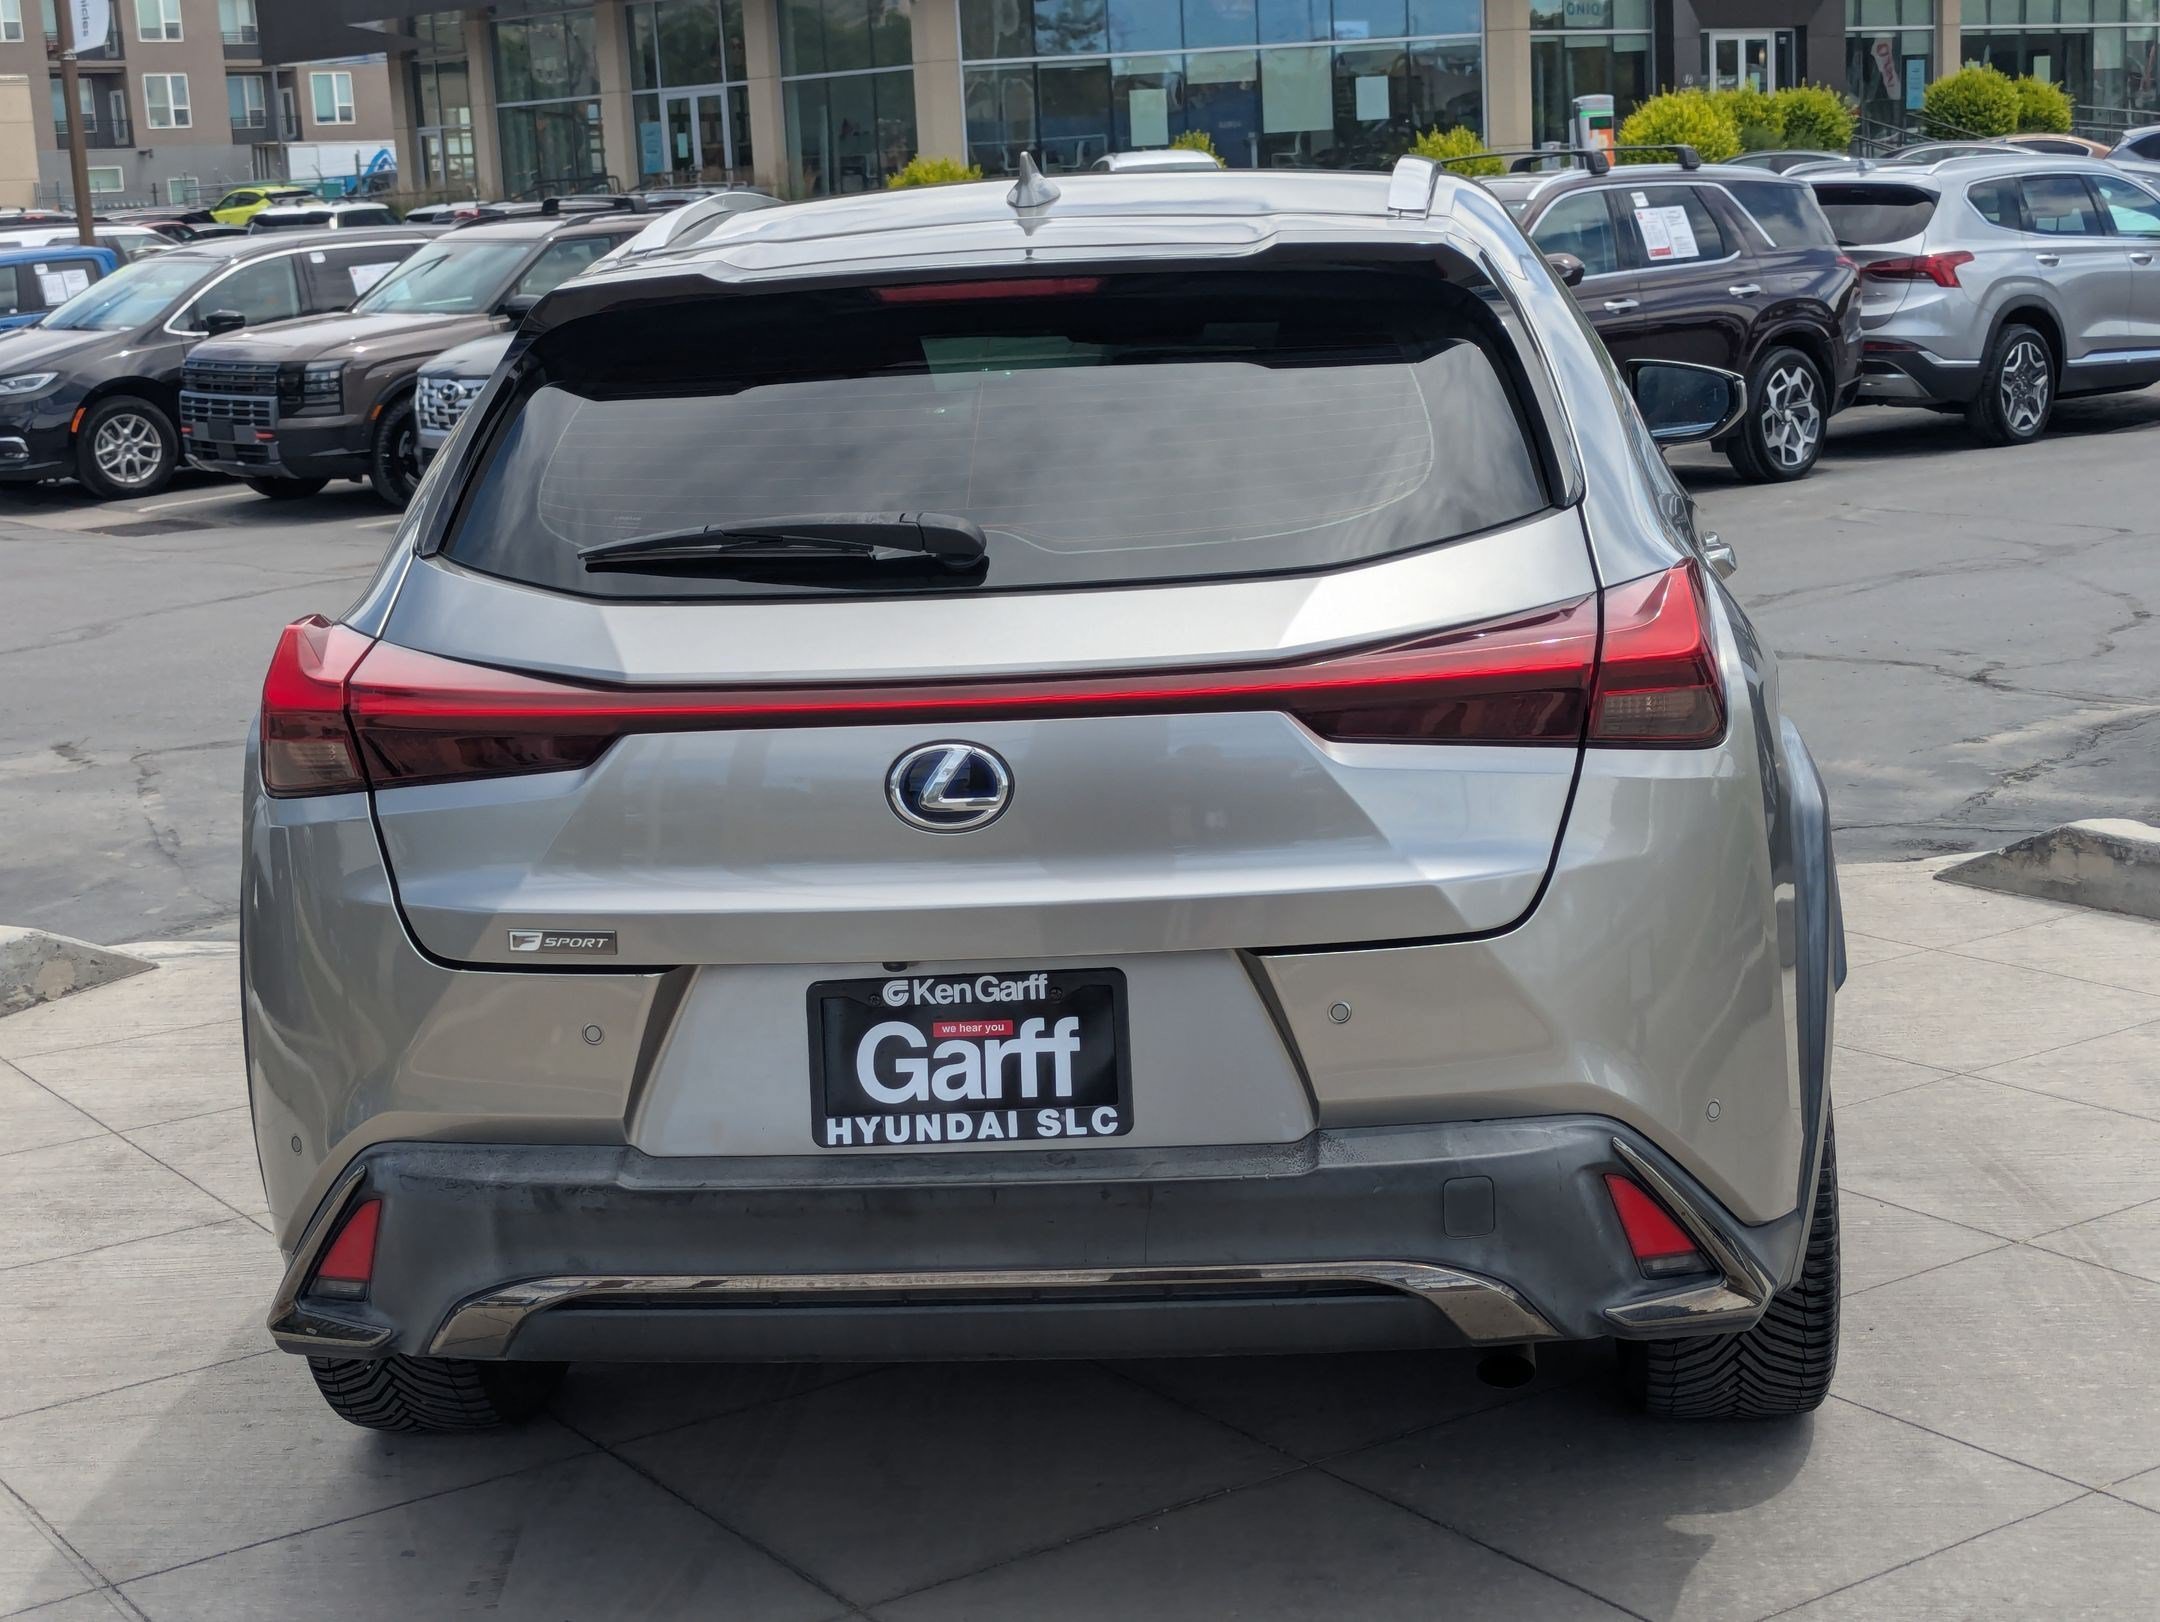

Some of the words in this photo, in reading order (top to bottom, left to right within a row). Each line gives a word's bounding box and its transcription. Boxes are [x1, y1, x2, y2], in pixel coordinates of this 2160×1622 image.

[544, 937, 609, 948] SPORT
[913, 977, 972, 1006] Ken
[975, 973, 1049, 1003] Garff
[941, 1024, 957, 1033] we
[959, 1022, 982, 1033] hear
[984, 1023, 1005, 1035] you
[856, 1016, 1080, 1104] Garff
[826, 1110, 1019, 1146] HYUNDAI
[1036, 1106, 1118, 1137] SLC
